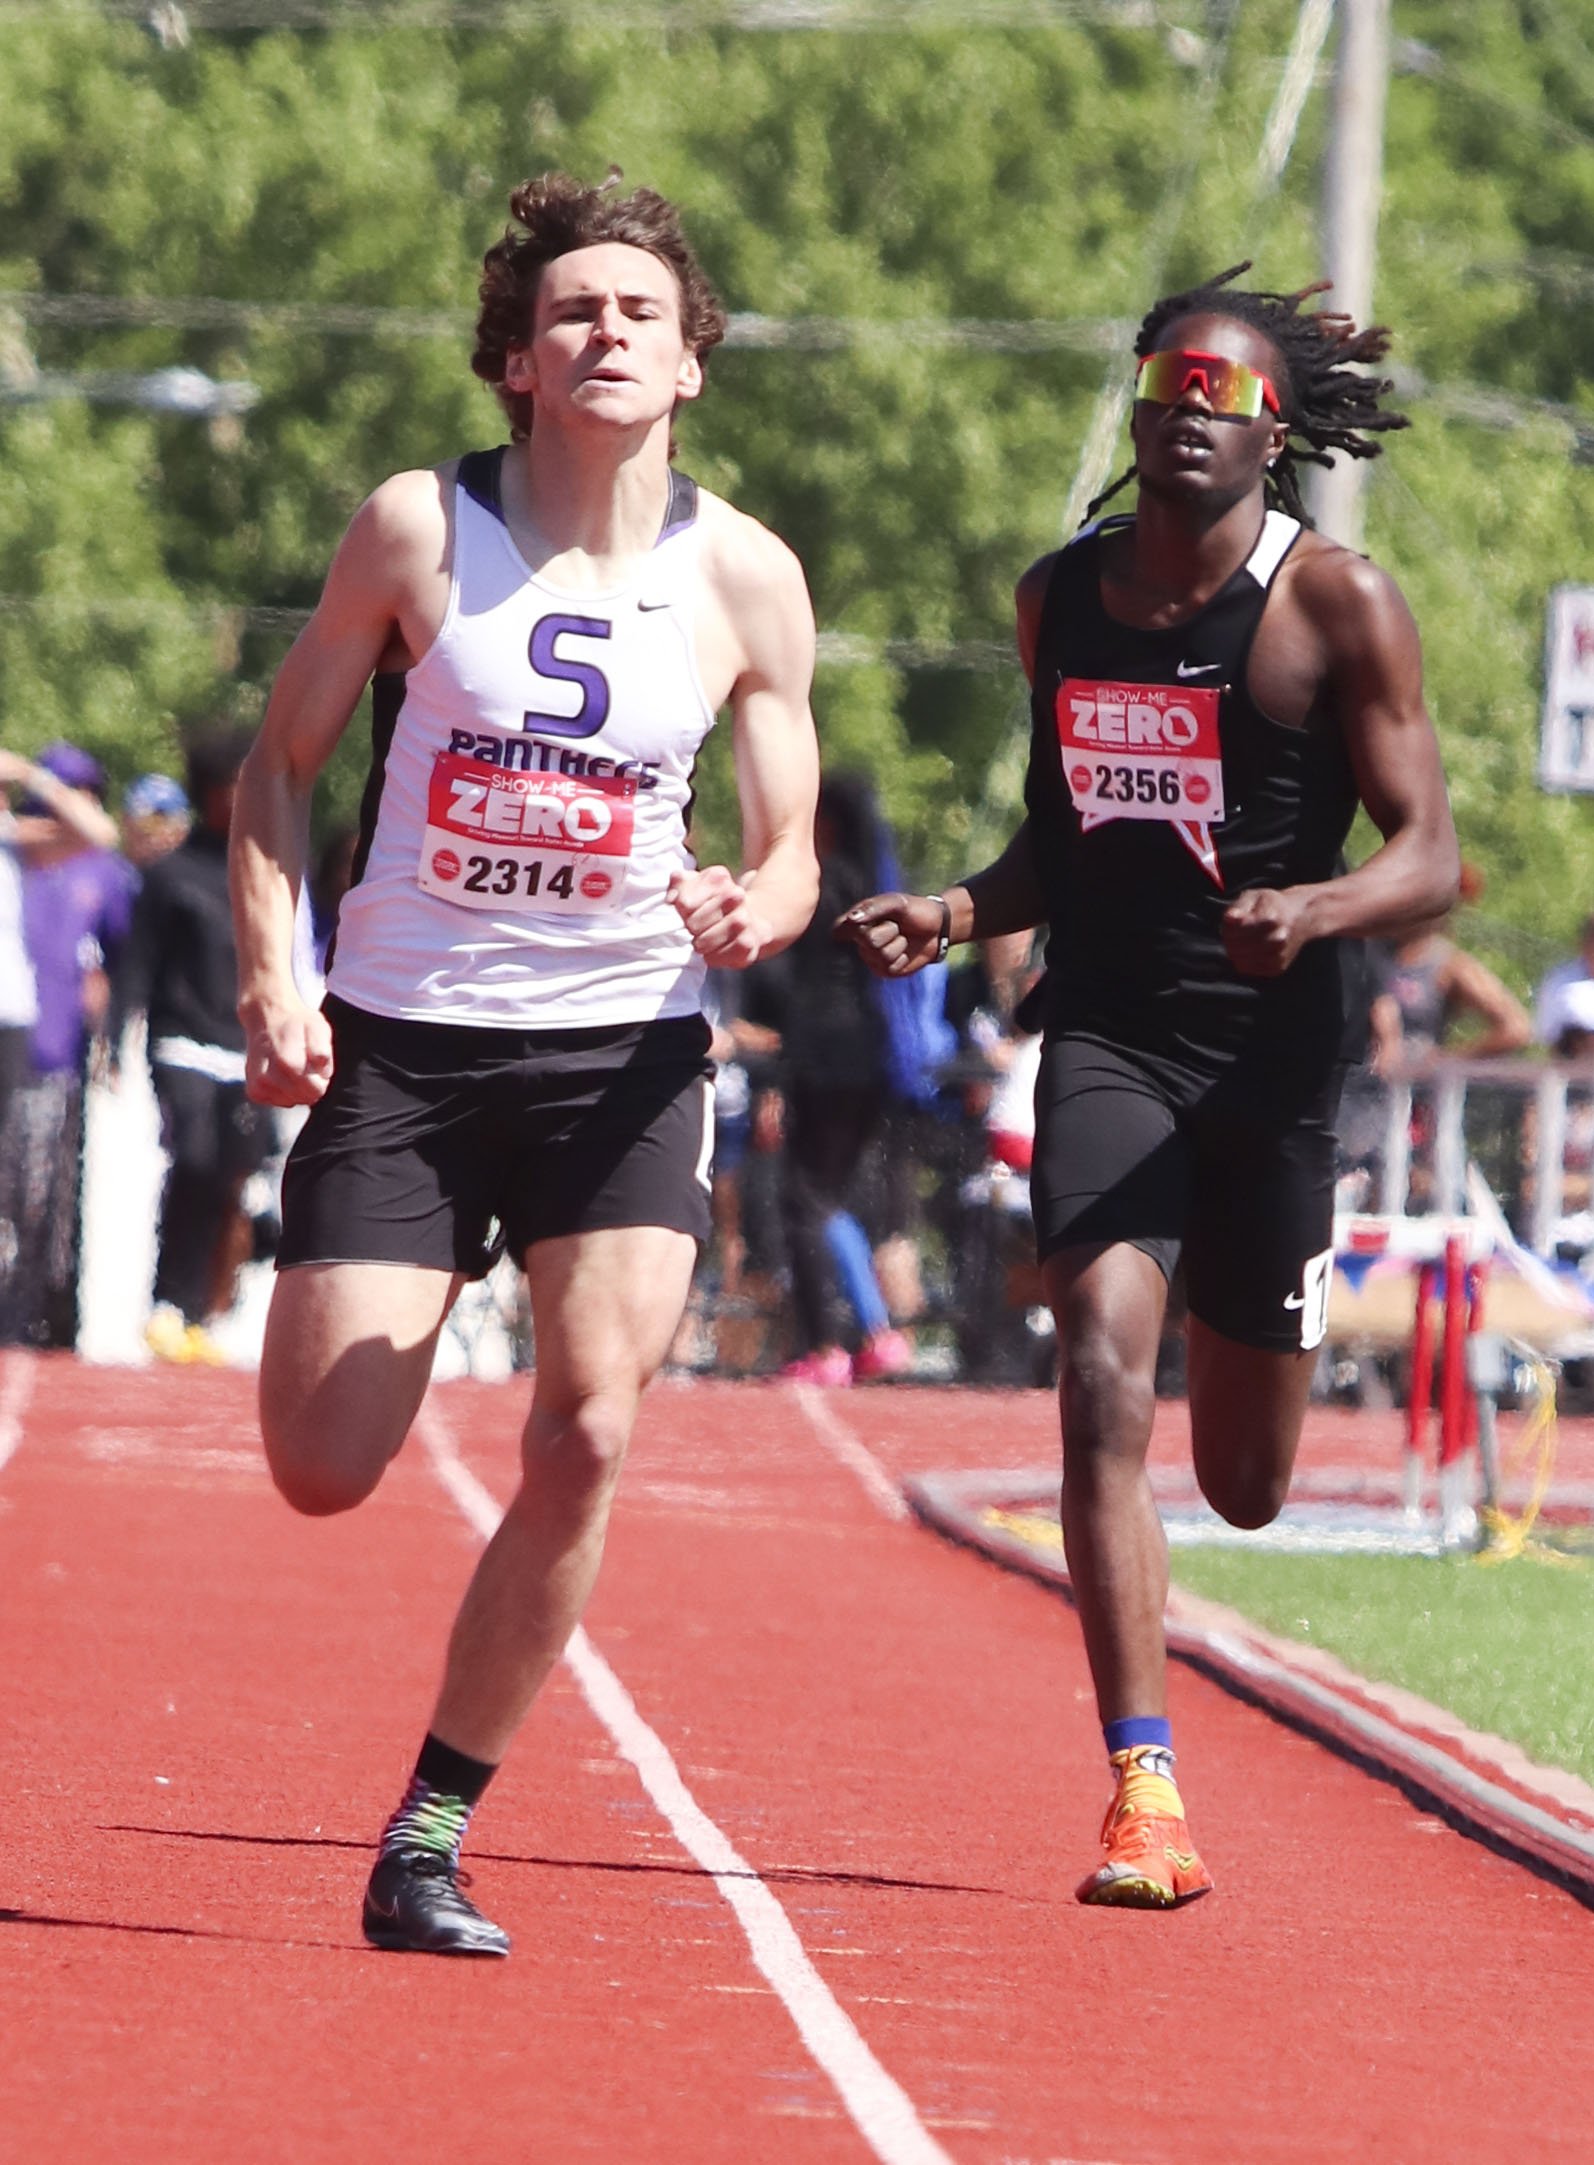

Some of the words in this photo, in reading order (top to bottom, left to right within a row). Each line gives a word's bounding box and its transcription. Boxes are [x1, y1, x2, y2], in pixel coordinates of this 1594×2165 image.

[522, 613, 612, 739] S
[1070, 698, 1198, 747] ZERO
[491, 774, 577, 798] SHOW-ME
[1096, 765, 1180, 805] 2356
[447, 778, 612, 842] ZERO
[464, 855, 575, 899] 2314
